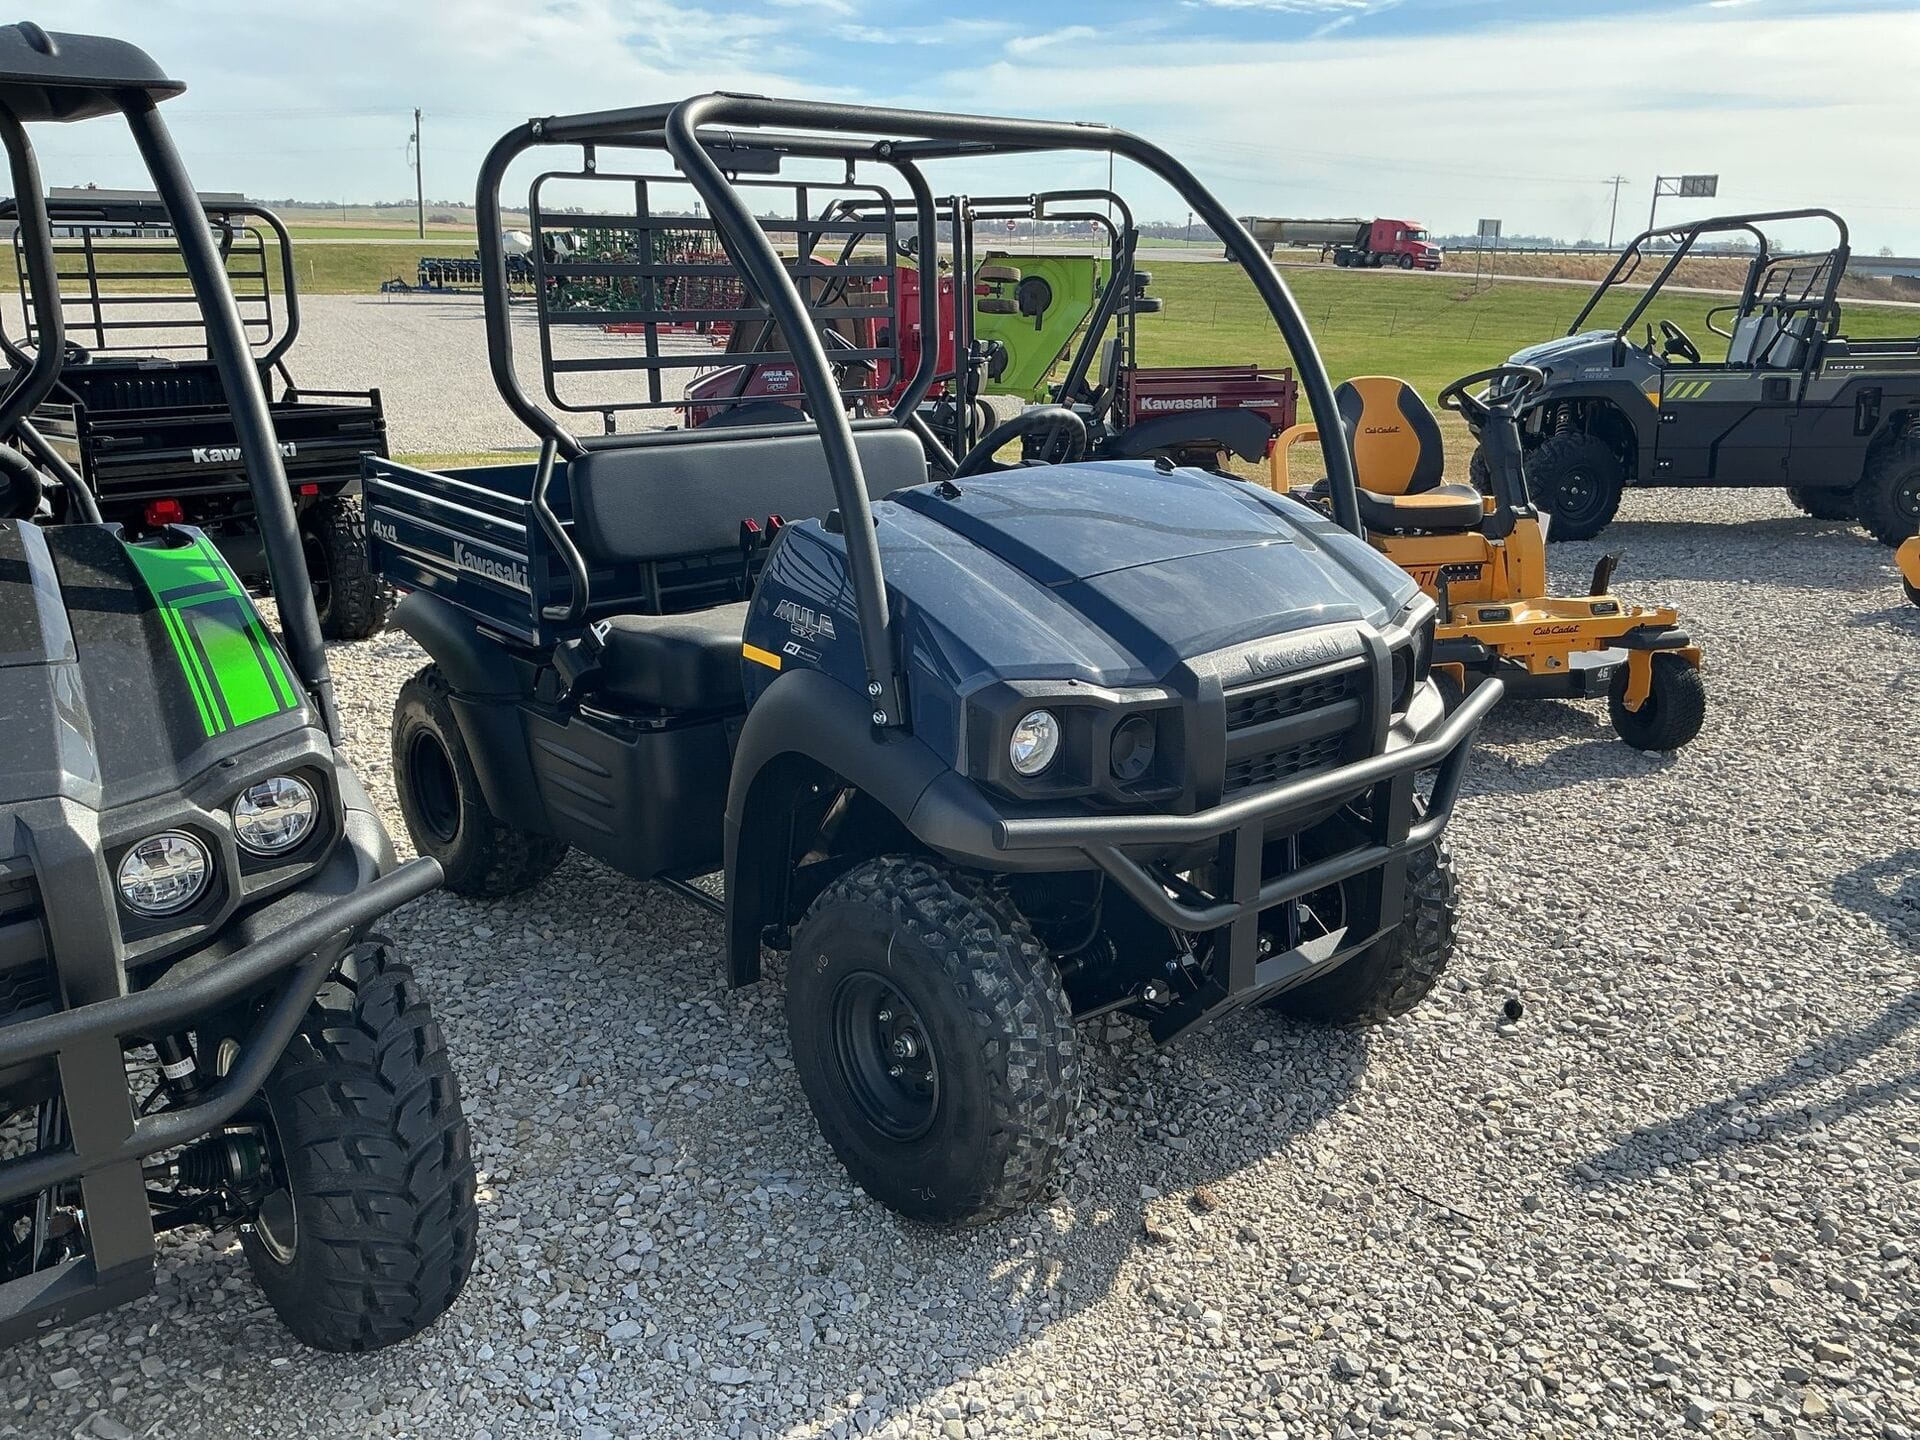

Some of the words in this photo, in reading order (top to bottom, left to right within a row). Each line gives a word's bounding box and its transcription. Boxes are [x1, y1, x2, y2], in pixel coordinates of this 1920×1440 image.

[1141, 396, 1217, 410] Kawasaki
[191, 442, 297, 463] Kawki
[373, 519, 398, 542] 4x4
[453, 540, 529, 587] Kawasaki
[773, 599, 837, 641] MULE
[1532, 627, 1551, 636] Cub
[1551, 624, 1581, 635] Cadet
[790, 623, 815, 642] SX
[1243, 636, 1344, 676] Kawasaki
